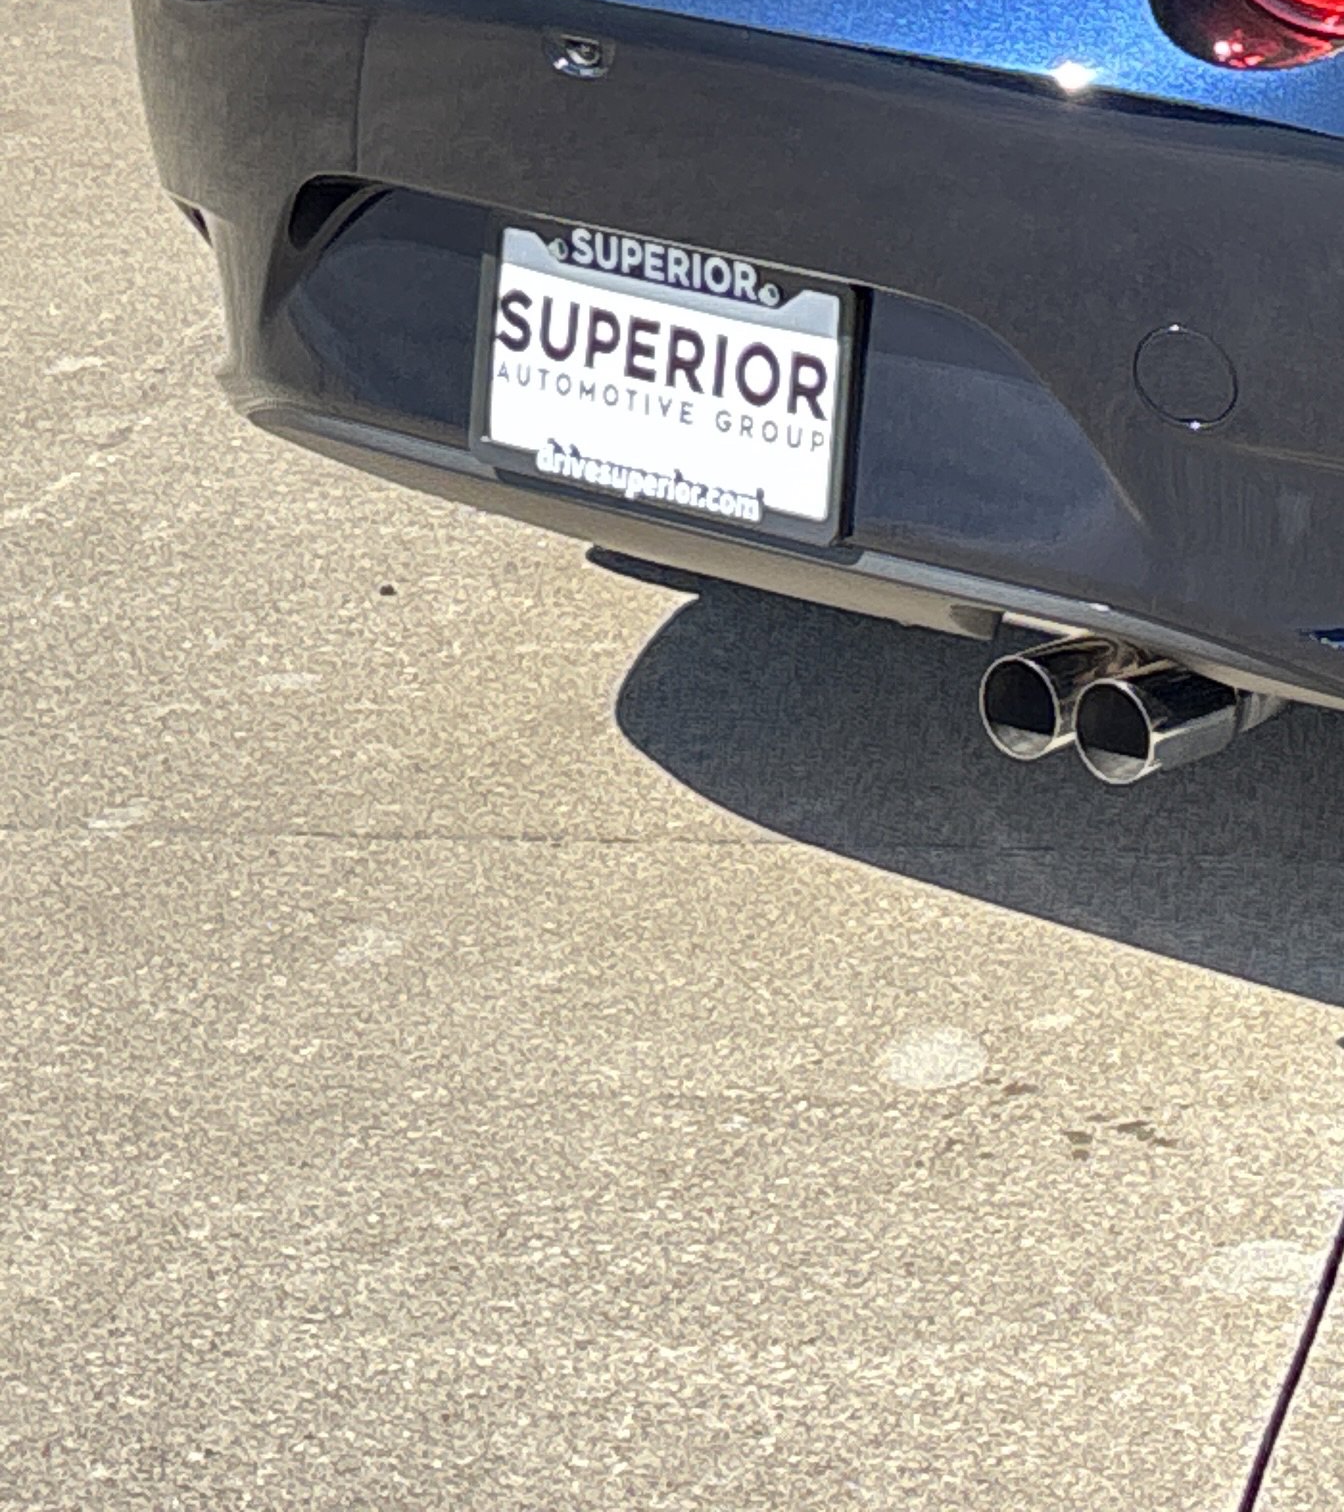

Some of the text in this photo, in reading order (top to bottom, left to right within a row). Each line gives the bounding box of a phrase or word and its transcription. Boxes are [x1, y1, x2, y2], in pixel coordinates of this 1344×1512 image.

[571, 228, 758, 301] SUPERIOR
[497, 288, 828, 421] SUPERIOR
[497, 361, 825, 453] AUTOMOTIVE GROUP
[536, 442, 762, 523] drivesuperior.com
